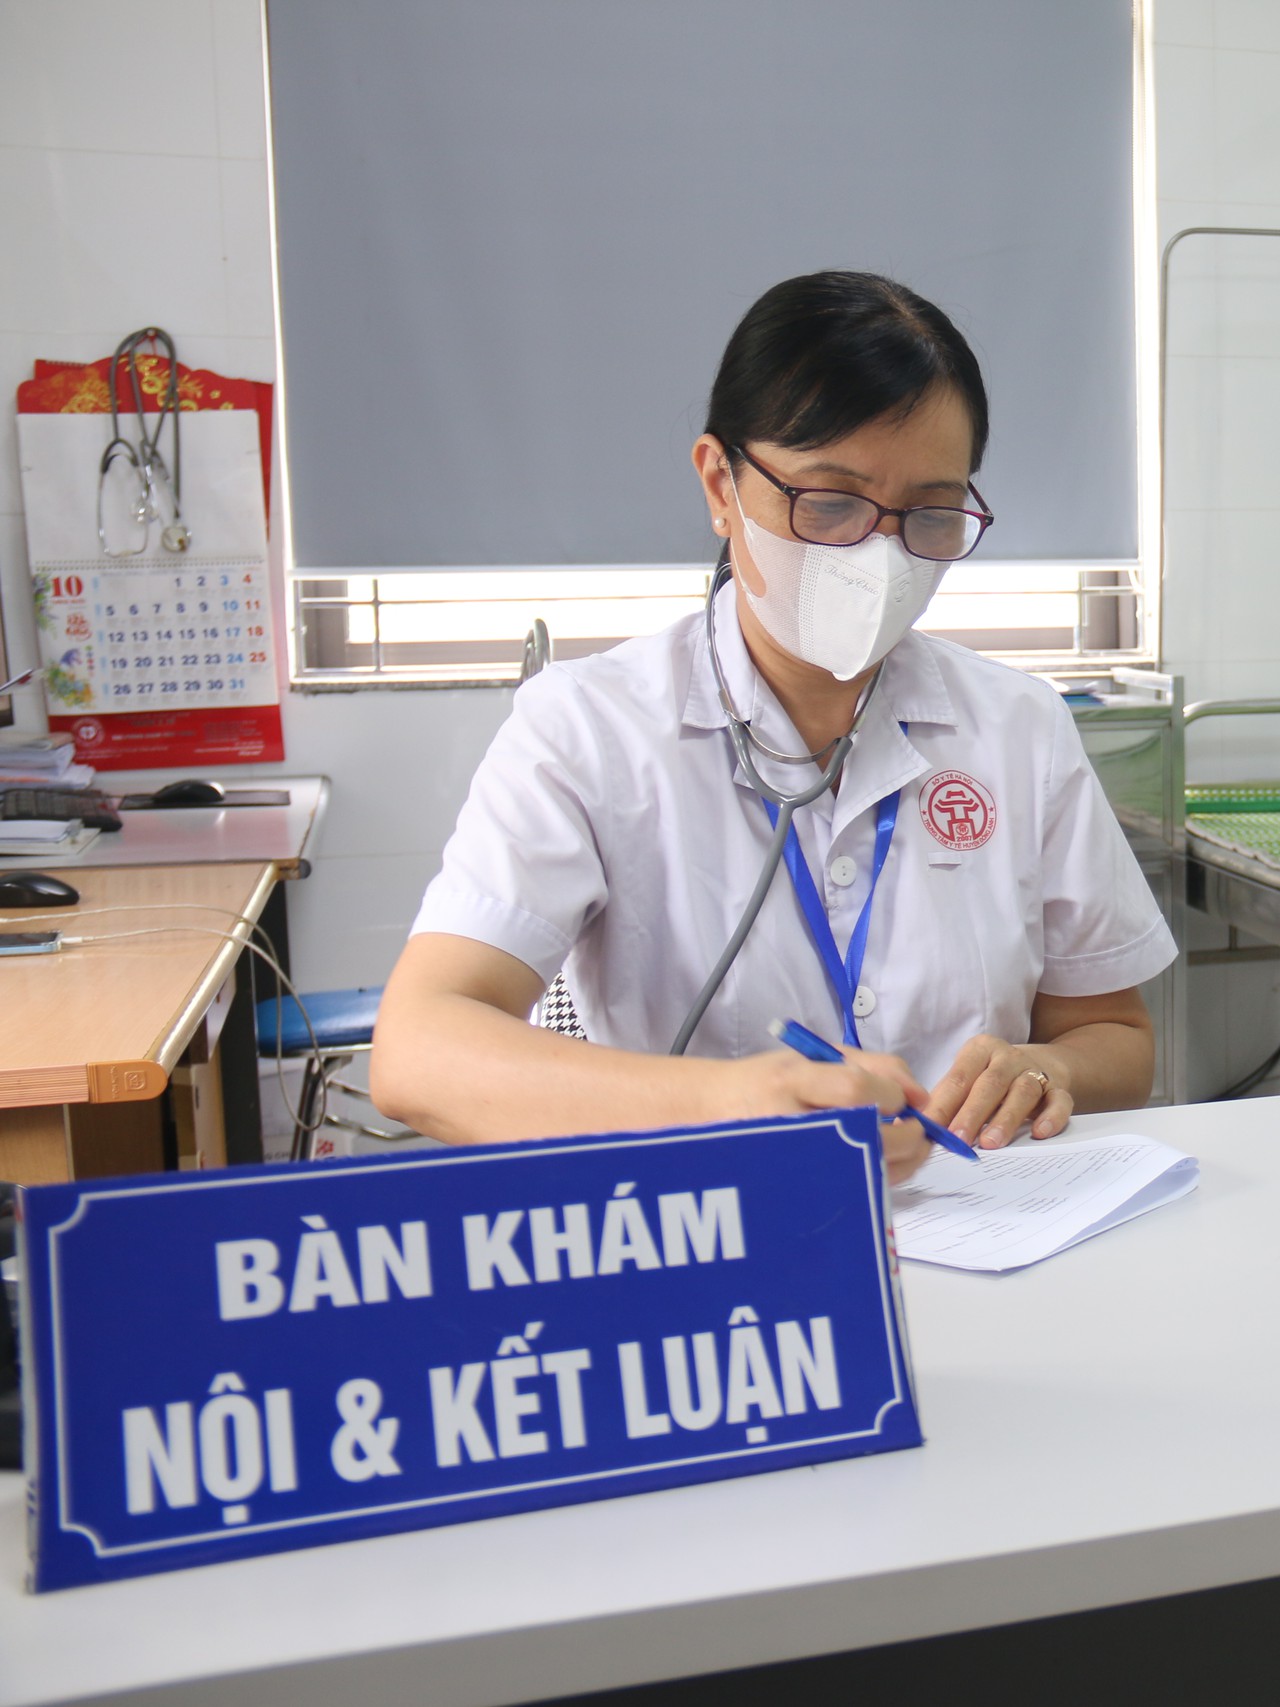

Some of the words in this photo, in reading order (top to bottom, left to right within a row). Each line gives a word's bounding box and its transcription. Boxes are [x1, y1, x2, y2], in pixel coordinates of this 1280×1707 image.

[52, 576, 83, 597] 10
[175, 577, 181, 587] 1
[198, 576, 206, 586] 2
[220, 576, 229, 585] 3
[243, 574, 252, 584] 4
[106, 605, 114, 615] 5
[129, 605, 138, 615] 6
[153, 604, 160, 613] 7
[176, 603, 185, 613] 8
[199, 602, 208, 612] 9
[223, 601, 239, 610] 10
[246, 600, 259, 609] 11
[109, 632, 125, 642] 12
[133, 631, 148, 641] 13
[156, 630, 172, 640] 14
[179, 630, 195, 639] 15
[202, 628, 218, 638] 16
[226, 627, 240, 637] 17
[248, 626, 263, 636] 18
[111, 659, 127, 668] 19
[134, 658, 151, 667] 20
[158, 657, 174, 666] 21
[181, 656, 198, 665] 22
[204, 655, 221, 664] 23
[227, 653, 243, 663] 24
[250, 652, 266, 662] 25
[114, 684, 131, 694] 26
[137, 683, 153, 693] 27
[160, 682, 177, 692] 28
[184, 681, 200, 691] 29
[207, 680, 223, 690] 30
[229, 679, 244, 689] 31
[217, 1215, 432, 1320] BÀN
[463, 1183, 745, 1291] KHÁM
[124, 1373, 296, 1524] NỘI
[331, 1379, 401, 1482] &
[430, 1322, 591, 1467] KẾT
[618, 1306, 841, 1444] LUẬN
